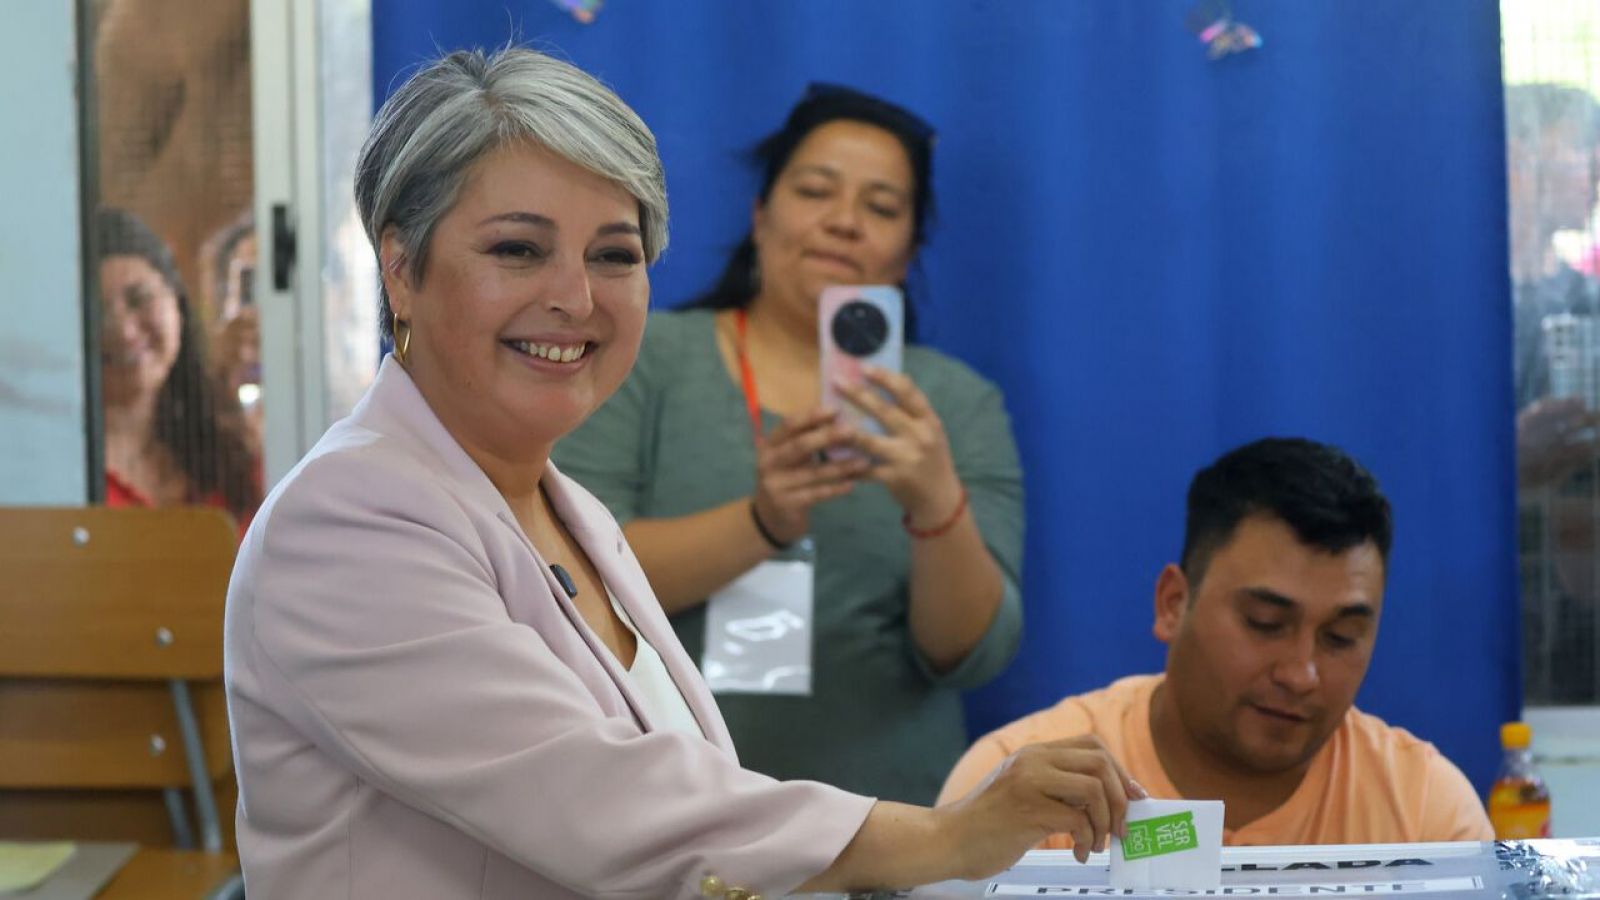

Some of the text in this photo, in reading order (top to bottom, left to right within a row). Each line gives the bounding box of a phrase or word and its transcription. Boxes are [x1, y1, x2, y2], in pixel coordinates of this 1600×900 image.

[1156, 823, 1174, 850] VEL
[1173, 821, 1191, 846] SER
[1220, 858, 1434, 871] LADA
